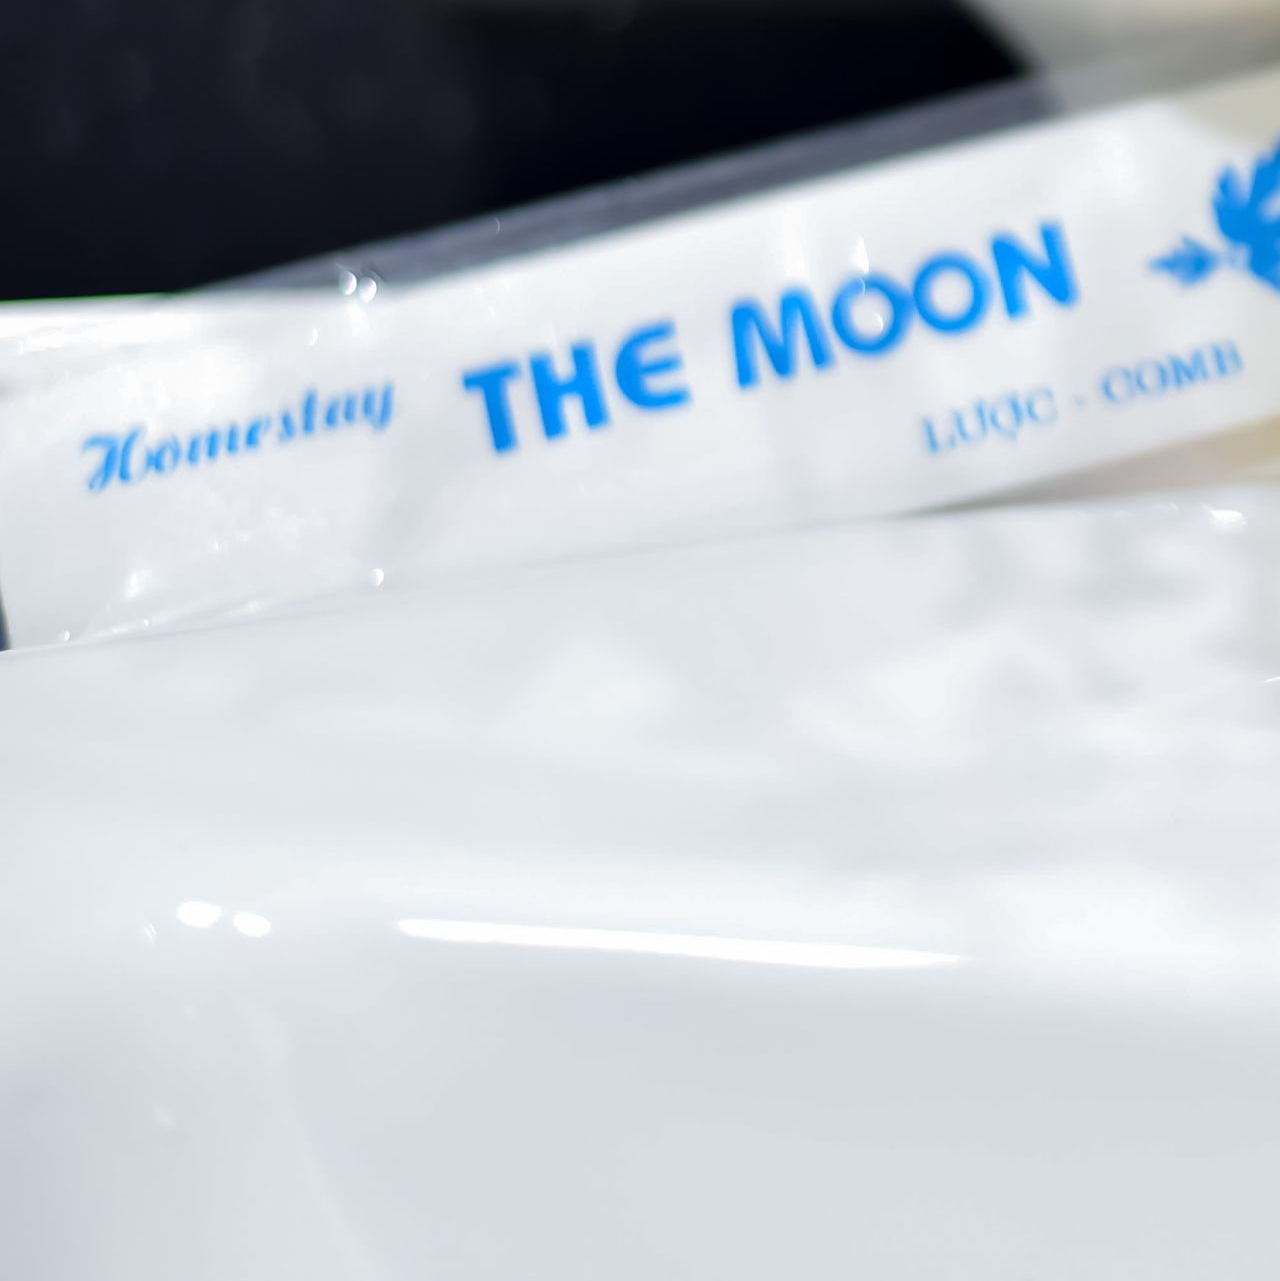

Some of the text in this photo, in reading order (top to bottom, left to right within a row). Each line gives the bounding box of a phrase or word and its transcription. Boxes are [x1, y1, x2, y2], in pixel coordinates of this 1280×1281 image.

[81, 220, 1079, 493] Homestay THE MOON
[1099, 340, 1244, 405] COMB
